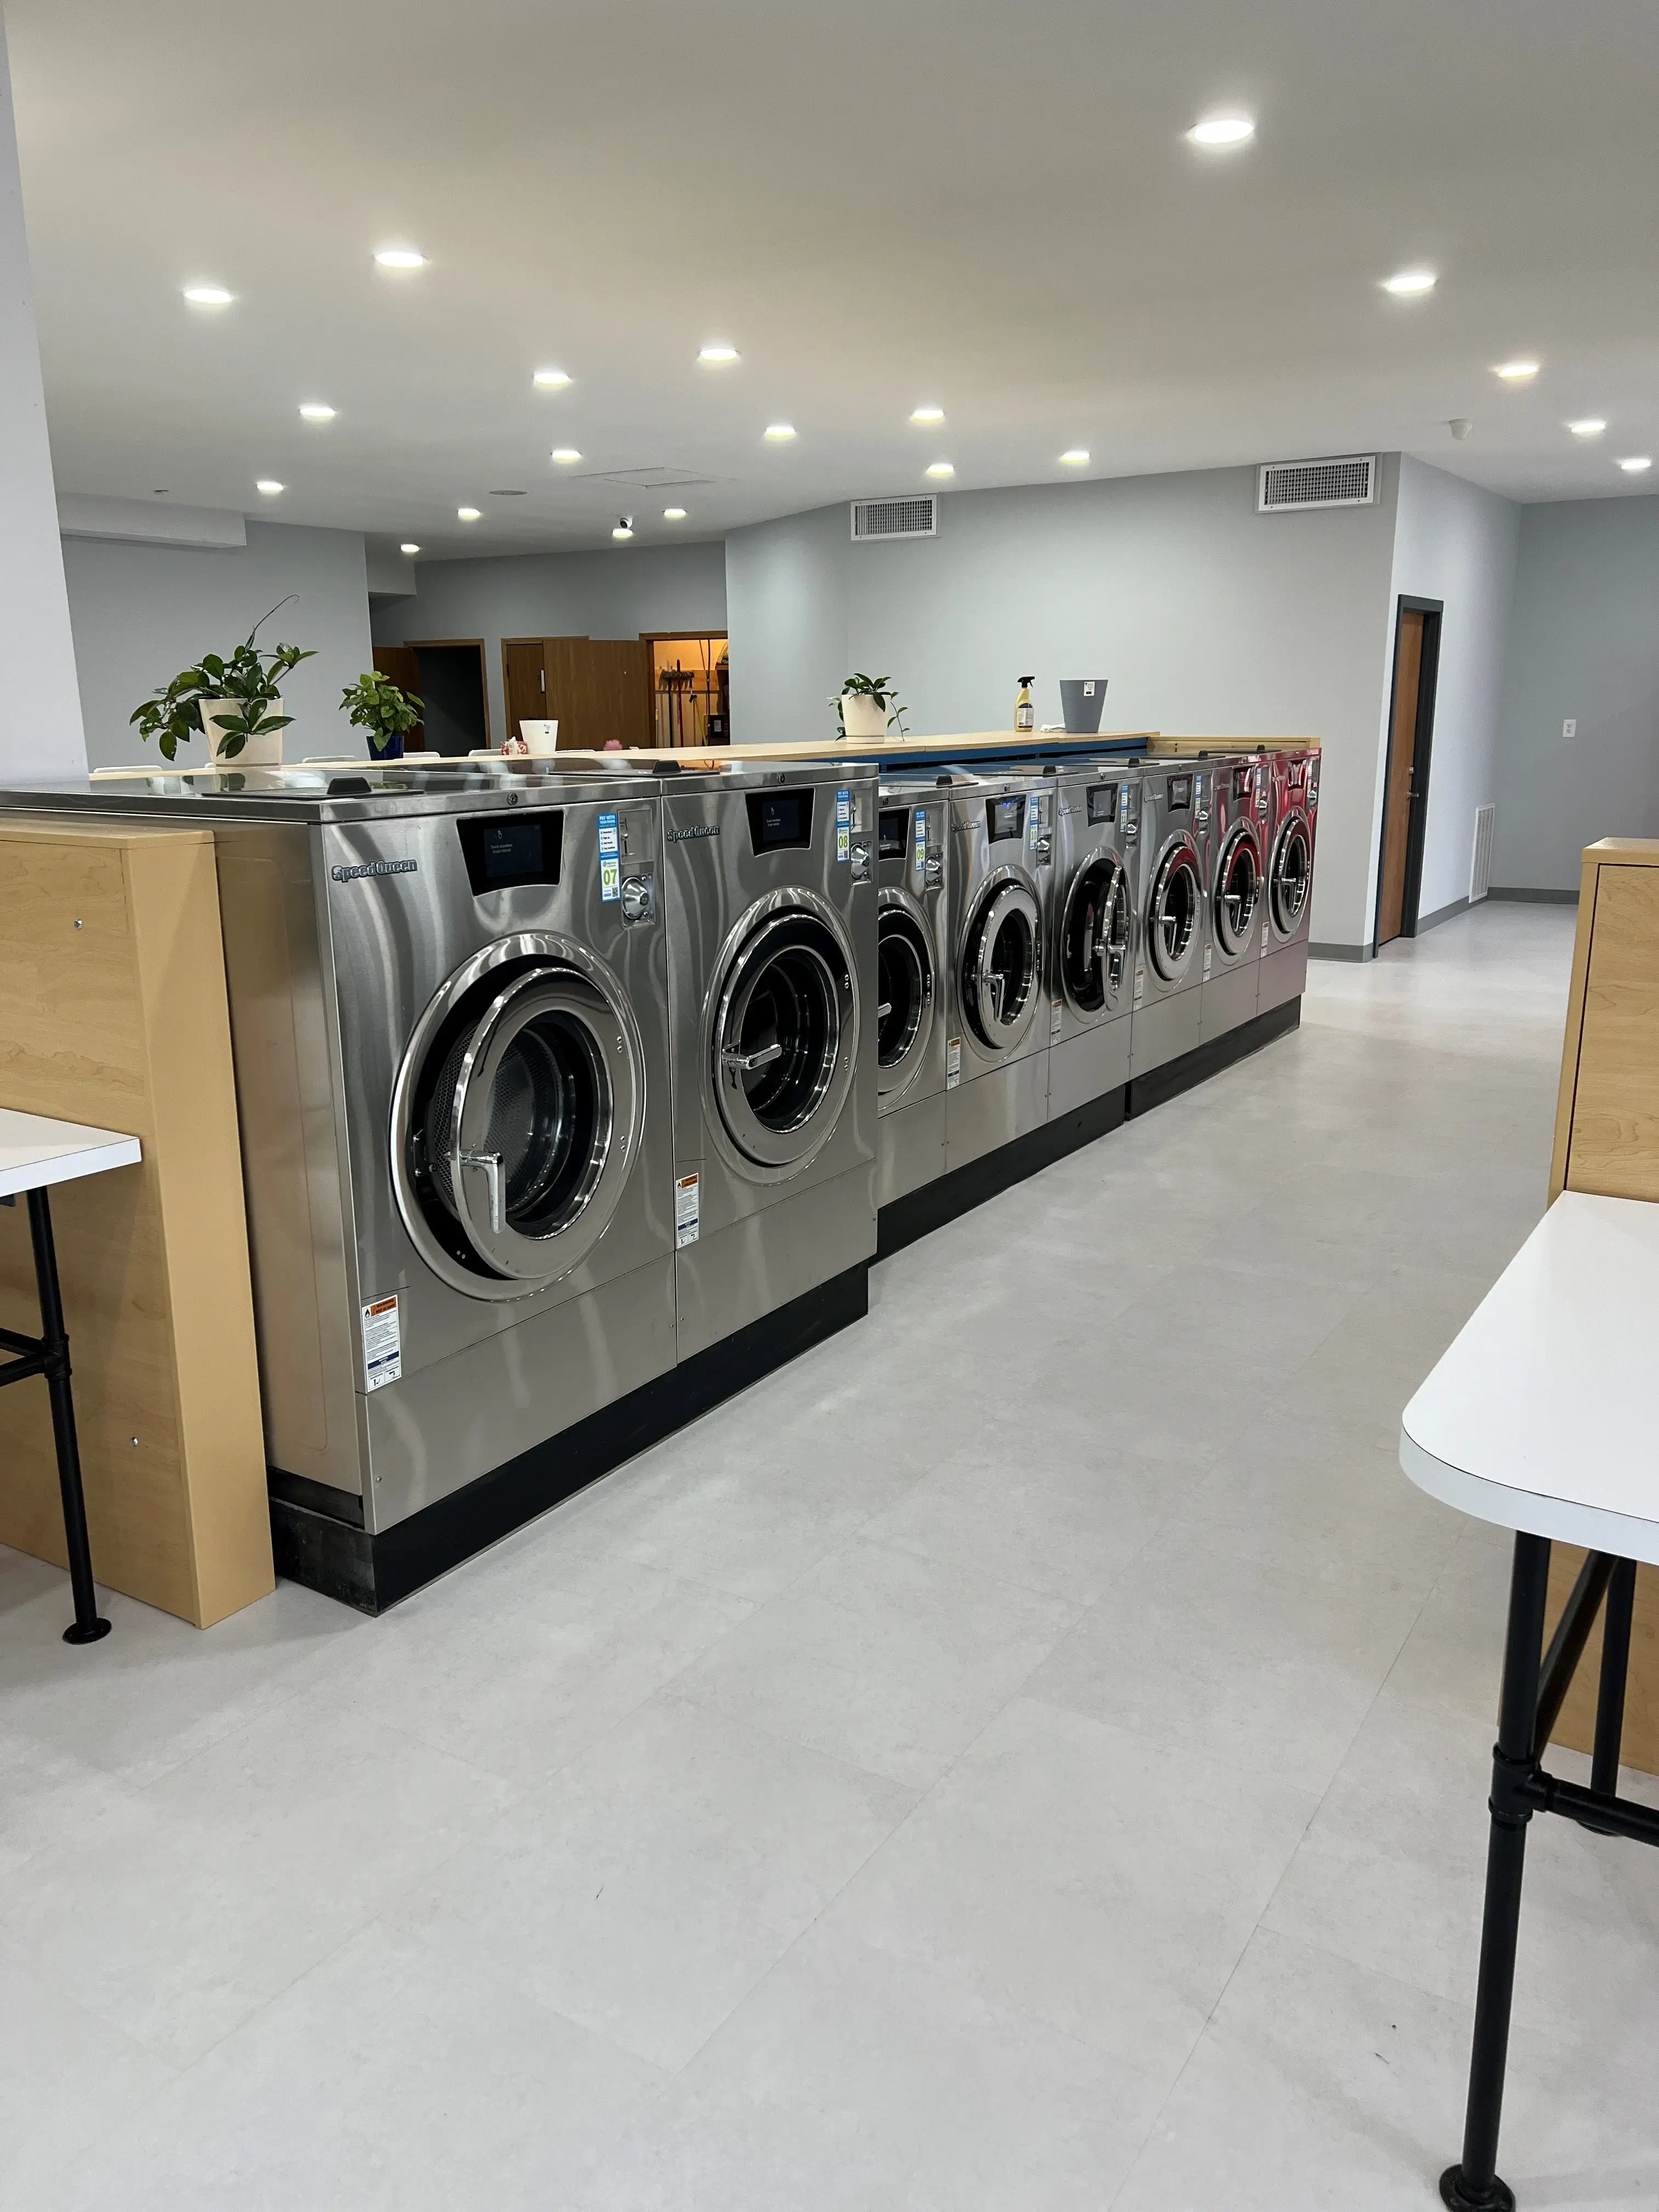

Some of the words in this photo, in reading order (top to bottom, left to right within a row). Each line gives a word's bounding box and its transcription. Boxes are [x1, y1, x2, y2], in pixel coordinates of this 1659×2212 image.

[667, 826, 695, 843] Speed
[695, 825, 720, 837] Queen
[838, 835, 848, 849] 08
[917, 849, 924, 860] 09
[332, 861, 376, 882] Speed
[376, 860, 417, 875] Queen
[603, 868, 617, 885] 07
